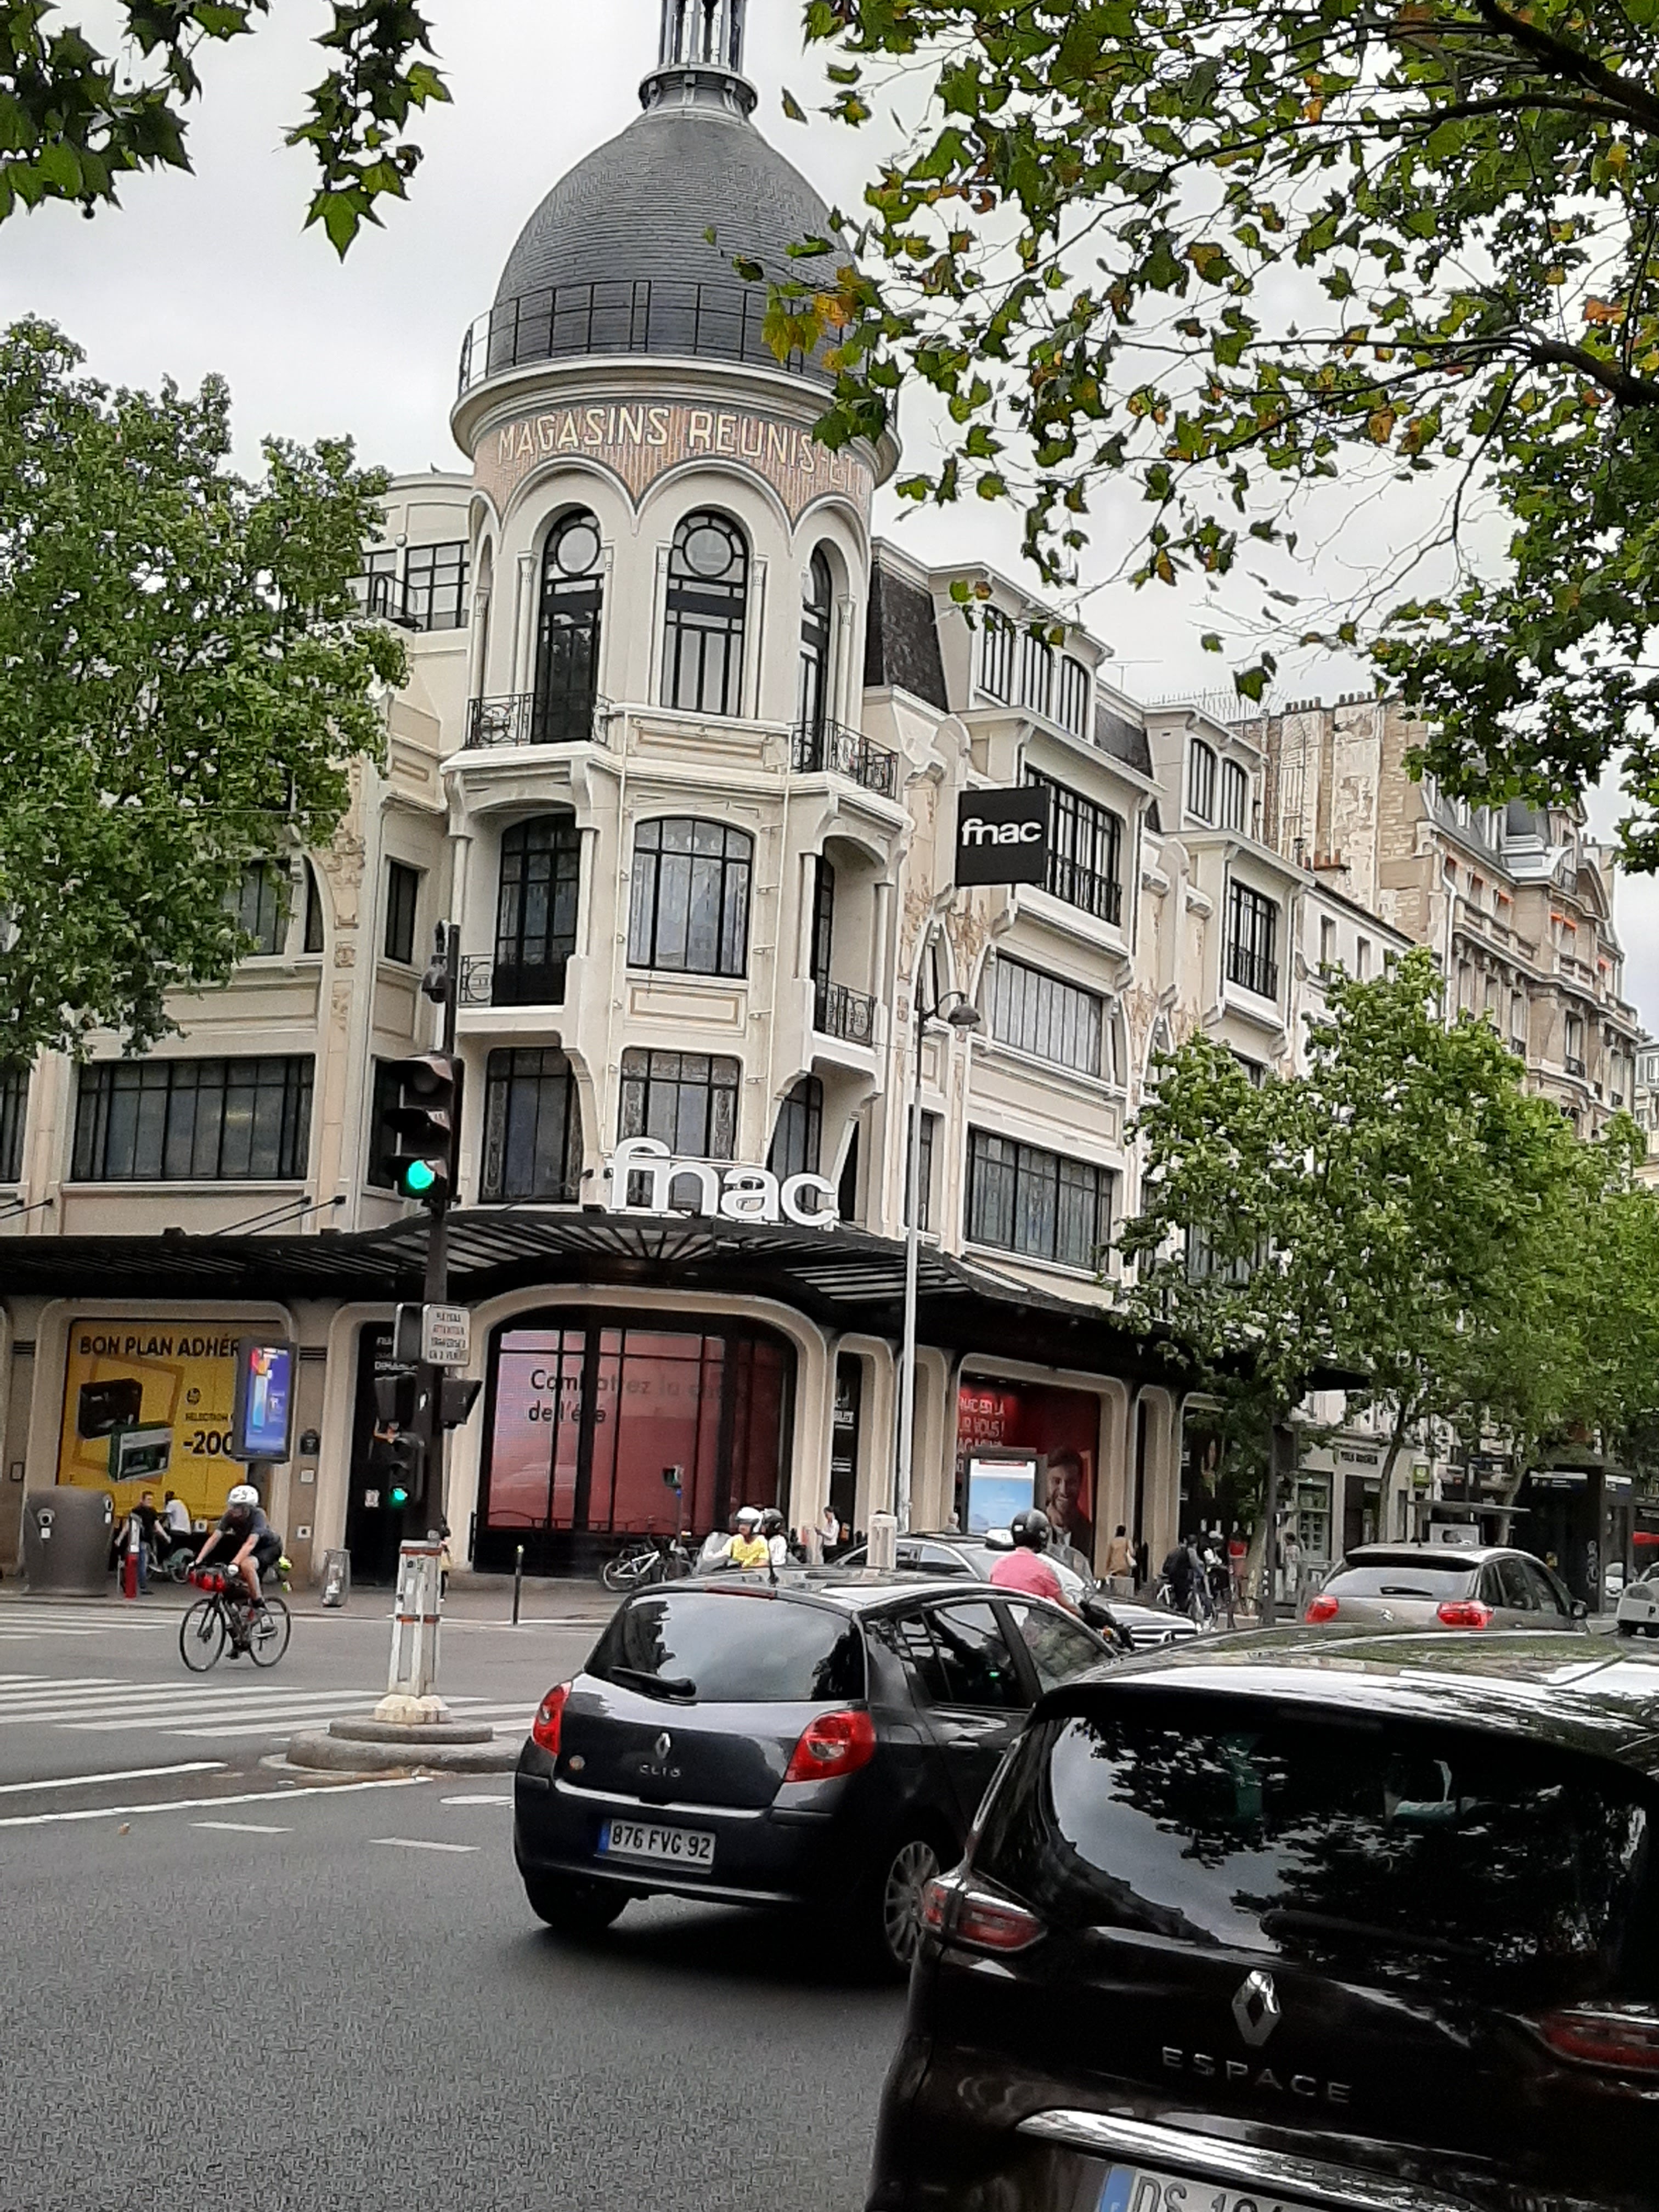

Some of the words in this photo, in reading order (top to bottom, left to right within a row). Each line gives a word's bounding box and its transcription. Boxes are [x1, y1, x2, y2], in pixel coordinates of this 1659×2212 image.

[499, 406, 669, 465] MAGASINS
[962, 817, 1042, 846] fnac
[610, 1136, 837, 1227] fnac
[79, 1334, 120, 1355] BON
[124, 1335, 173, 1357] PLAN
[528, 1399, 552, 1422] de
[612, 1825, 644, 1849] 876
[687, 1836, 711, 1859] 92
[1161, 2046, 1352, 2104] ESPACE
